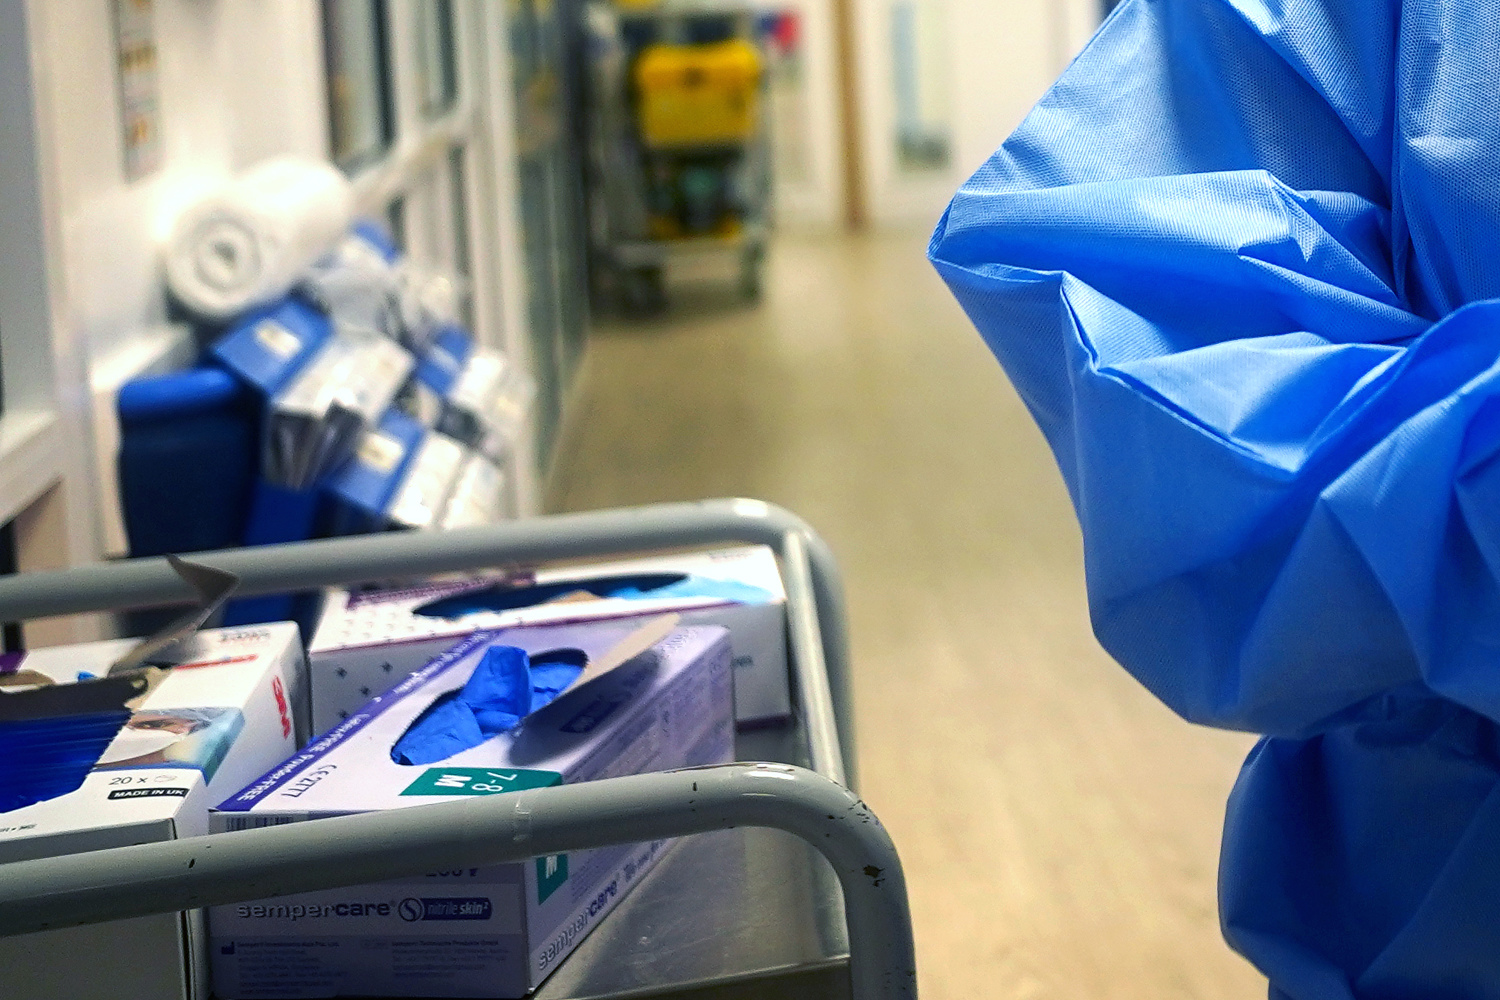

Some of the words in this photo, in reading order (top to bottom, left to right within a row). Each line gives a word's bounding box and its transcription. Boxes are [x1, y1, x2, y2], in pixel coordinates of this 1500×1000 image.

[108, 776, 132, 787] 20
[434, 773, 472, 788] M
[471, 770, 518, 792] 7-8
[113, 789, 149, 799] MADE
[150, 788, 165, 797] IN
[166, 788, 185, 797] UK
[237, 901, 391, 922] sempercare
[426, 901, 458, 915] nitrile
